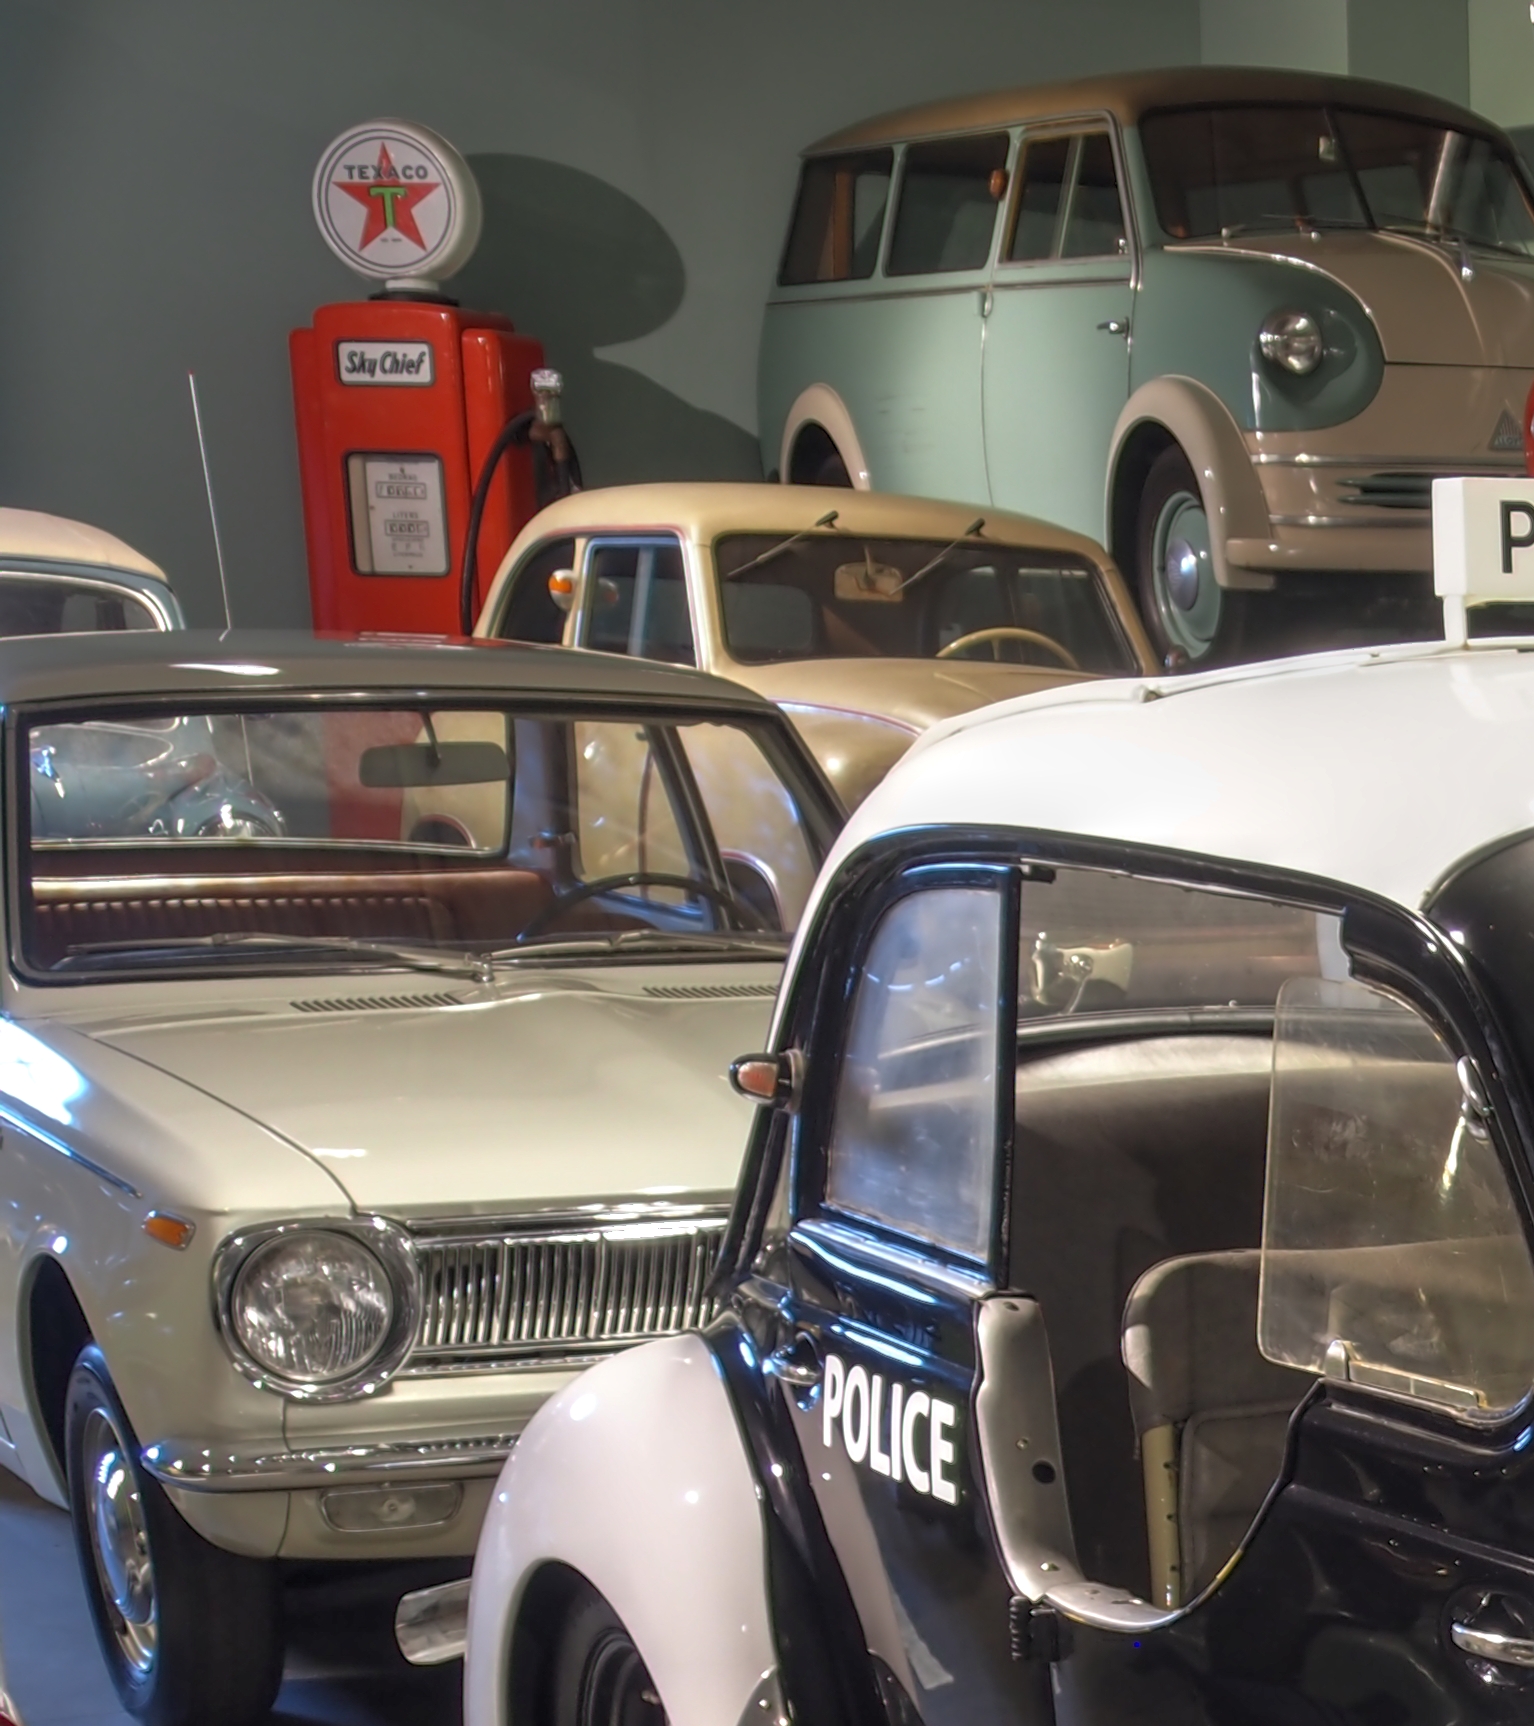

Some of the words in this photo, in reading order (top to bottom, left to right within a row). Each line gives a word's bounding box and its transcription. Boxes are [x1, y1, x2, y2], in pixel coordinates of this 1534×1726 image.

[344, 164, 429, 180] TEXACO
[369, 186, 408, 229] T
[345, 350, 377, 378] Sky
[380, 351, 426, 374] Chief
[823, 1354, 957, 1506] POLICE
